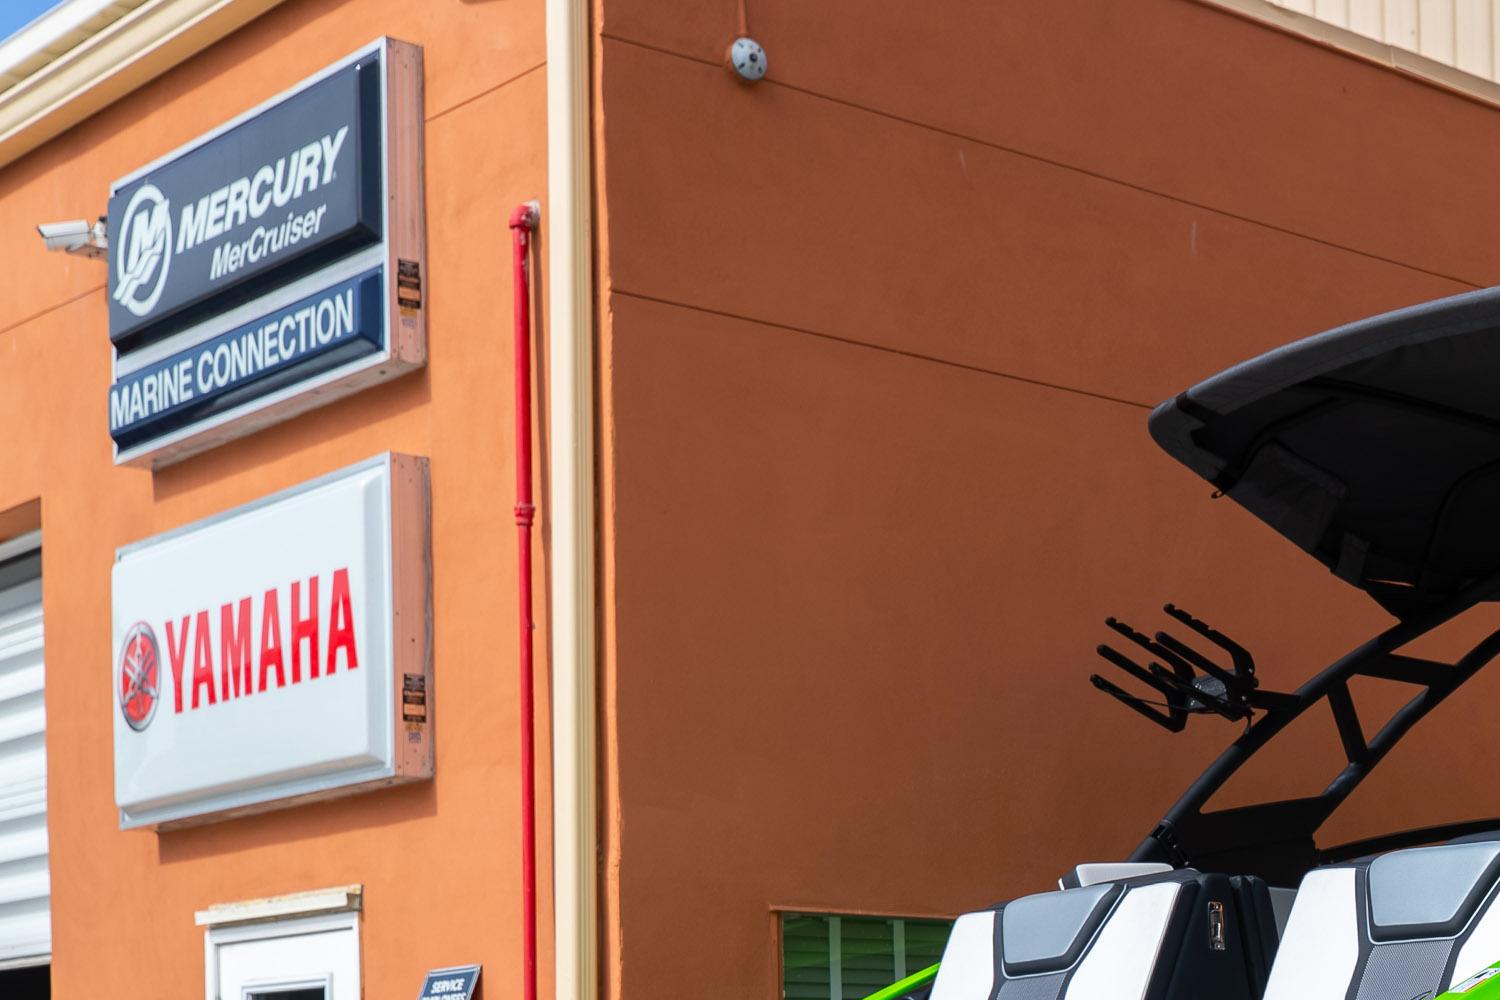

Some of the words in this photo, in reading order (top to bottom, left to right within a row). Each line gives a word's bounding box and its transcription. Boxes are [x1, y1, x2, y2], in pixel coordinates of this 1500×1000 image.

[176, 126, 349, 254] MERCURY
[210, 201, 327, 281] MerCruiser
[111, 360, 193, 431] MARINE
[198, 289, 354, 394] CONNECTION
[165, 568, 360, 714] YAMAHA
[431, 978, 465, 993] SERVICE
